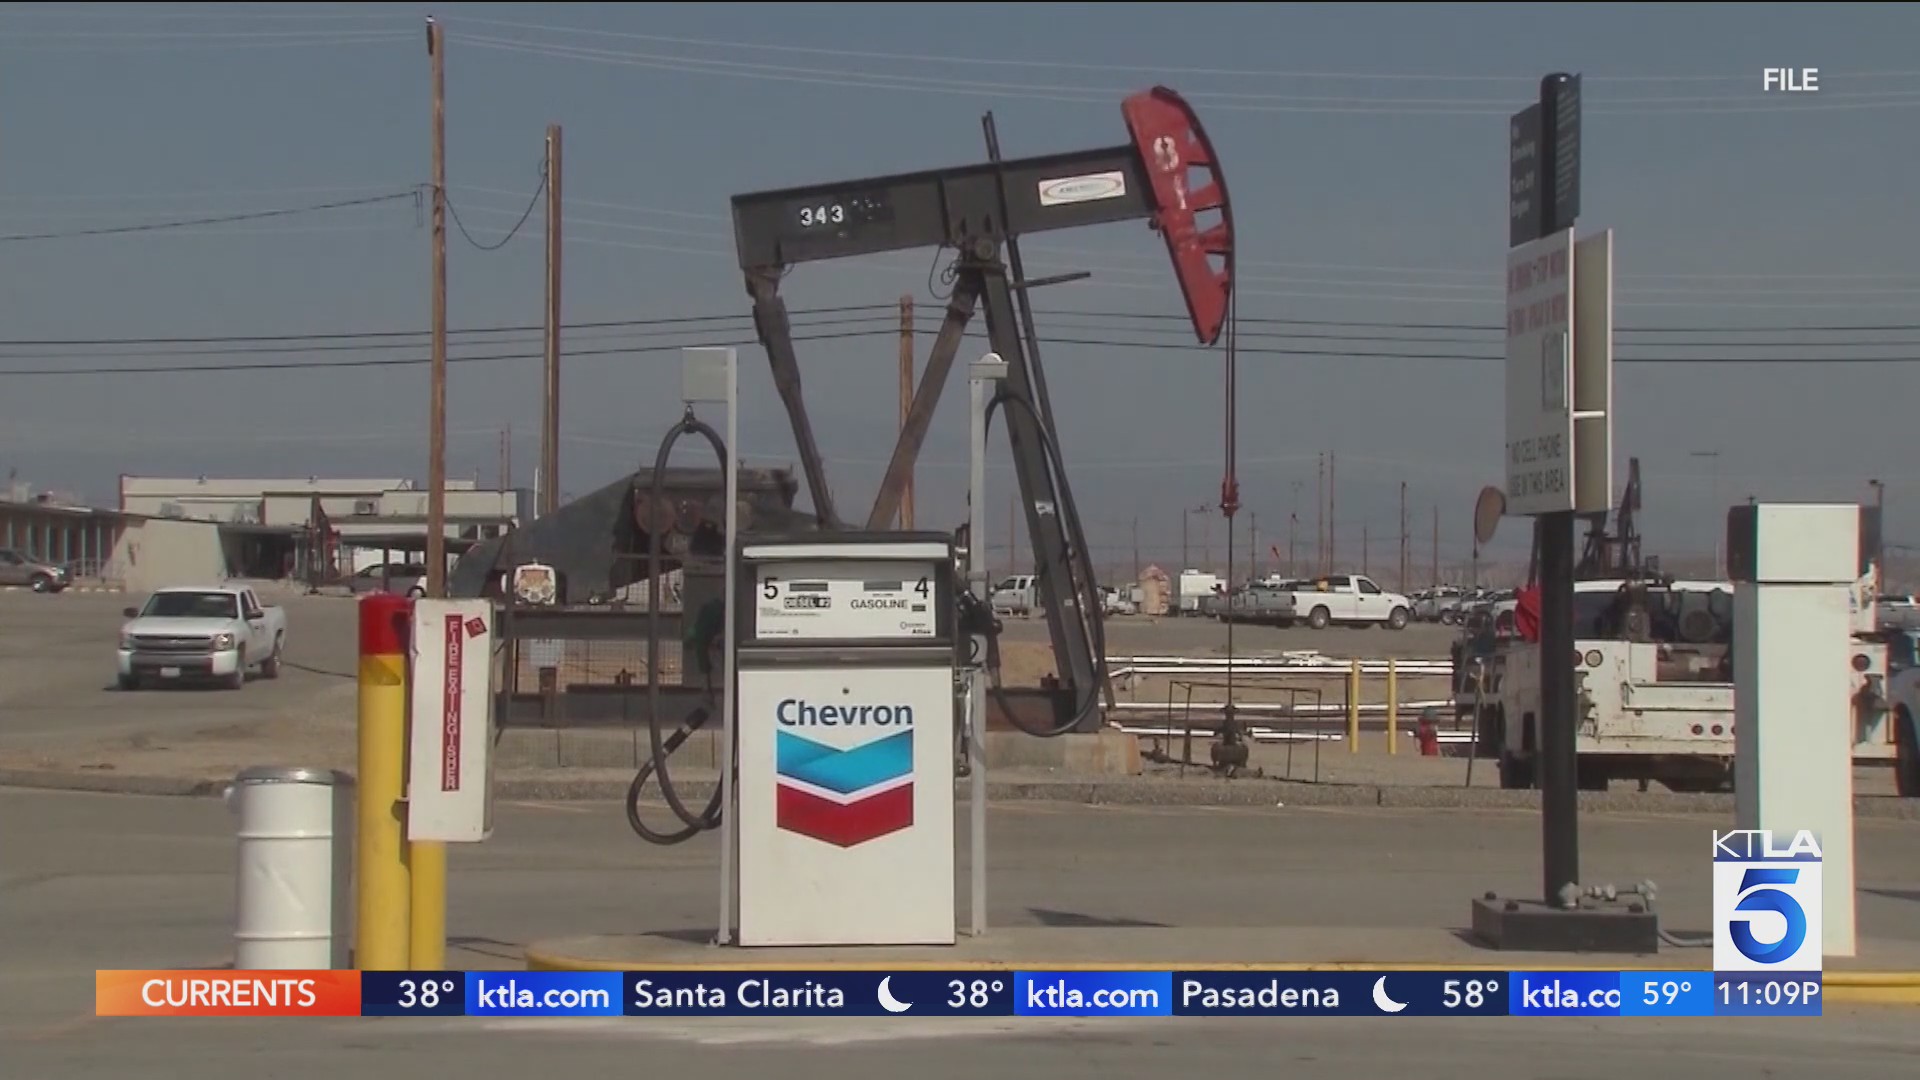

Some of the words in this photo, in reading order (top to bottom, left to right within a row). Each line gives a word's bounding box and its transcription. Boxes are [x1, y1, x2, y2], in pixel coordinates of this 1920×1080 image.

[800, 205, 844, 227] 343
[1521, 438, 1537, 462] CELL
[1538, 433, 1561, 459] PHONE
[1545, 467, 1564, 492] AREA
[763, 577, 779, 600] 5
[914, 576, 929, 600] 4
[850, 599, 908, 610] GASOLINE
[448, 621, 459, 665] FIRE
[776, 699, 913, 726] Chevron
